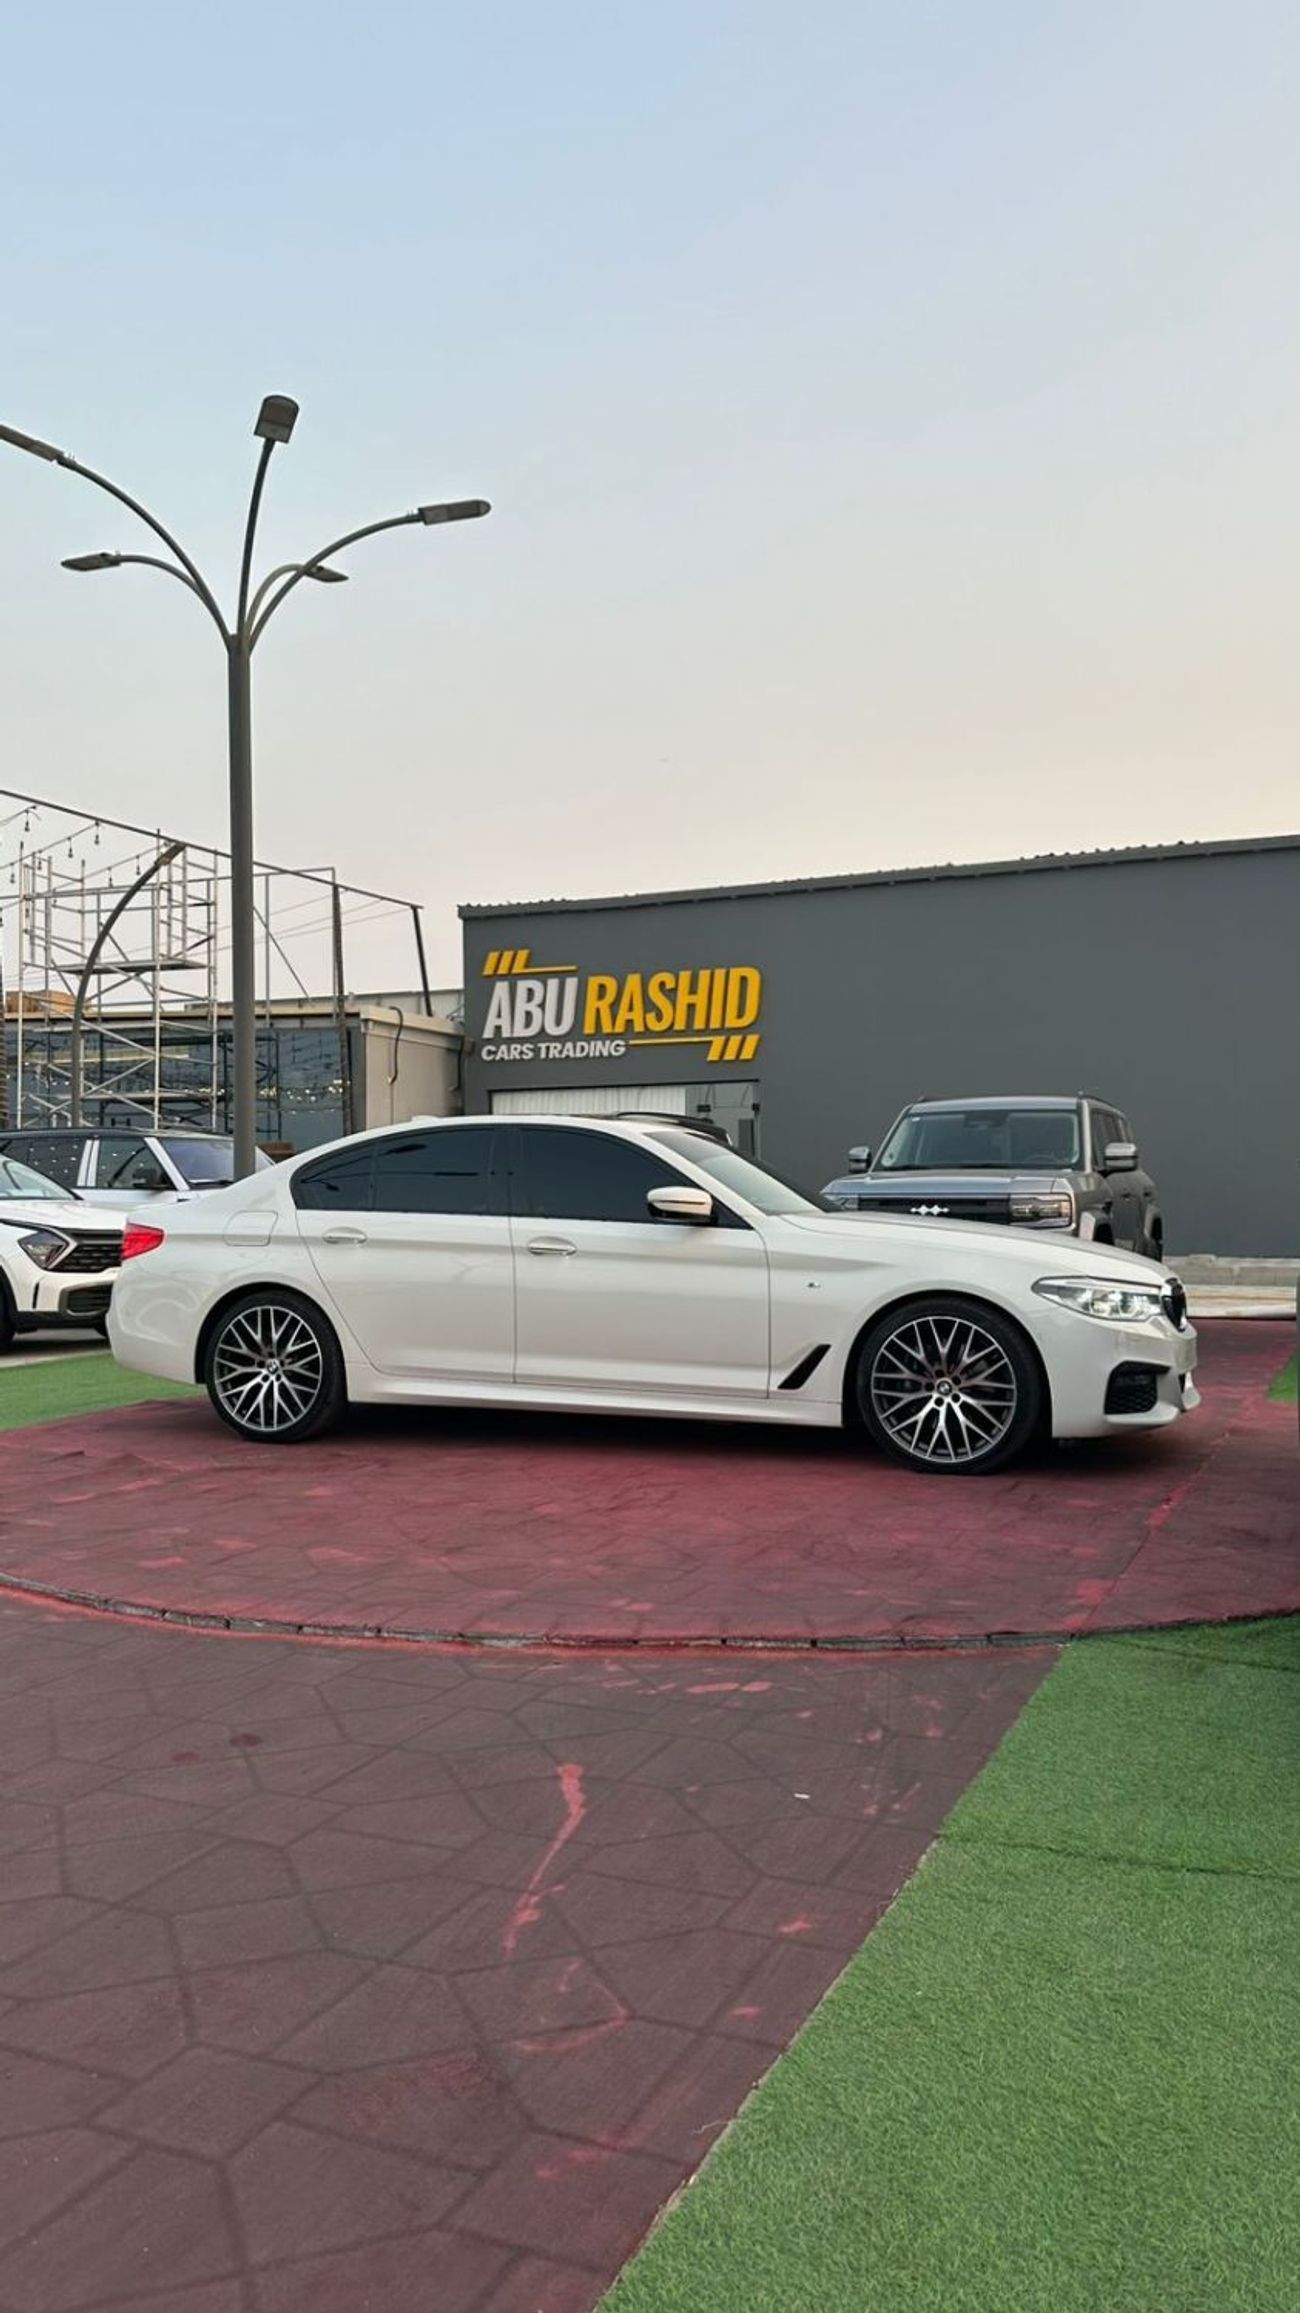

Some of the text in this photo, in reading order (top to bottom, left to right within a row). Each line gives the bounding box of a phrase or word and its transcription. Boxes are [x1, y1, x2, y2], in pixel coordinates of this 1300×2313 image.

[482, 966, 761, 1039] ABU RASHID
[481, 1039, 627, 1061] CARS TRADING
